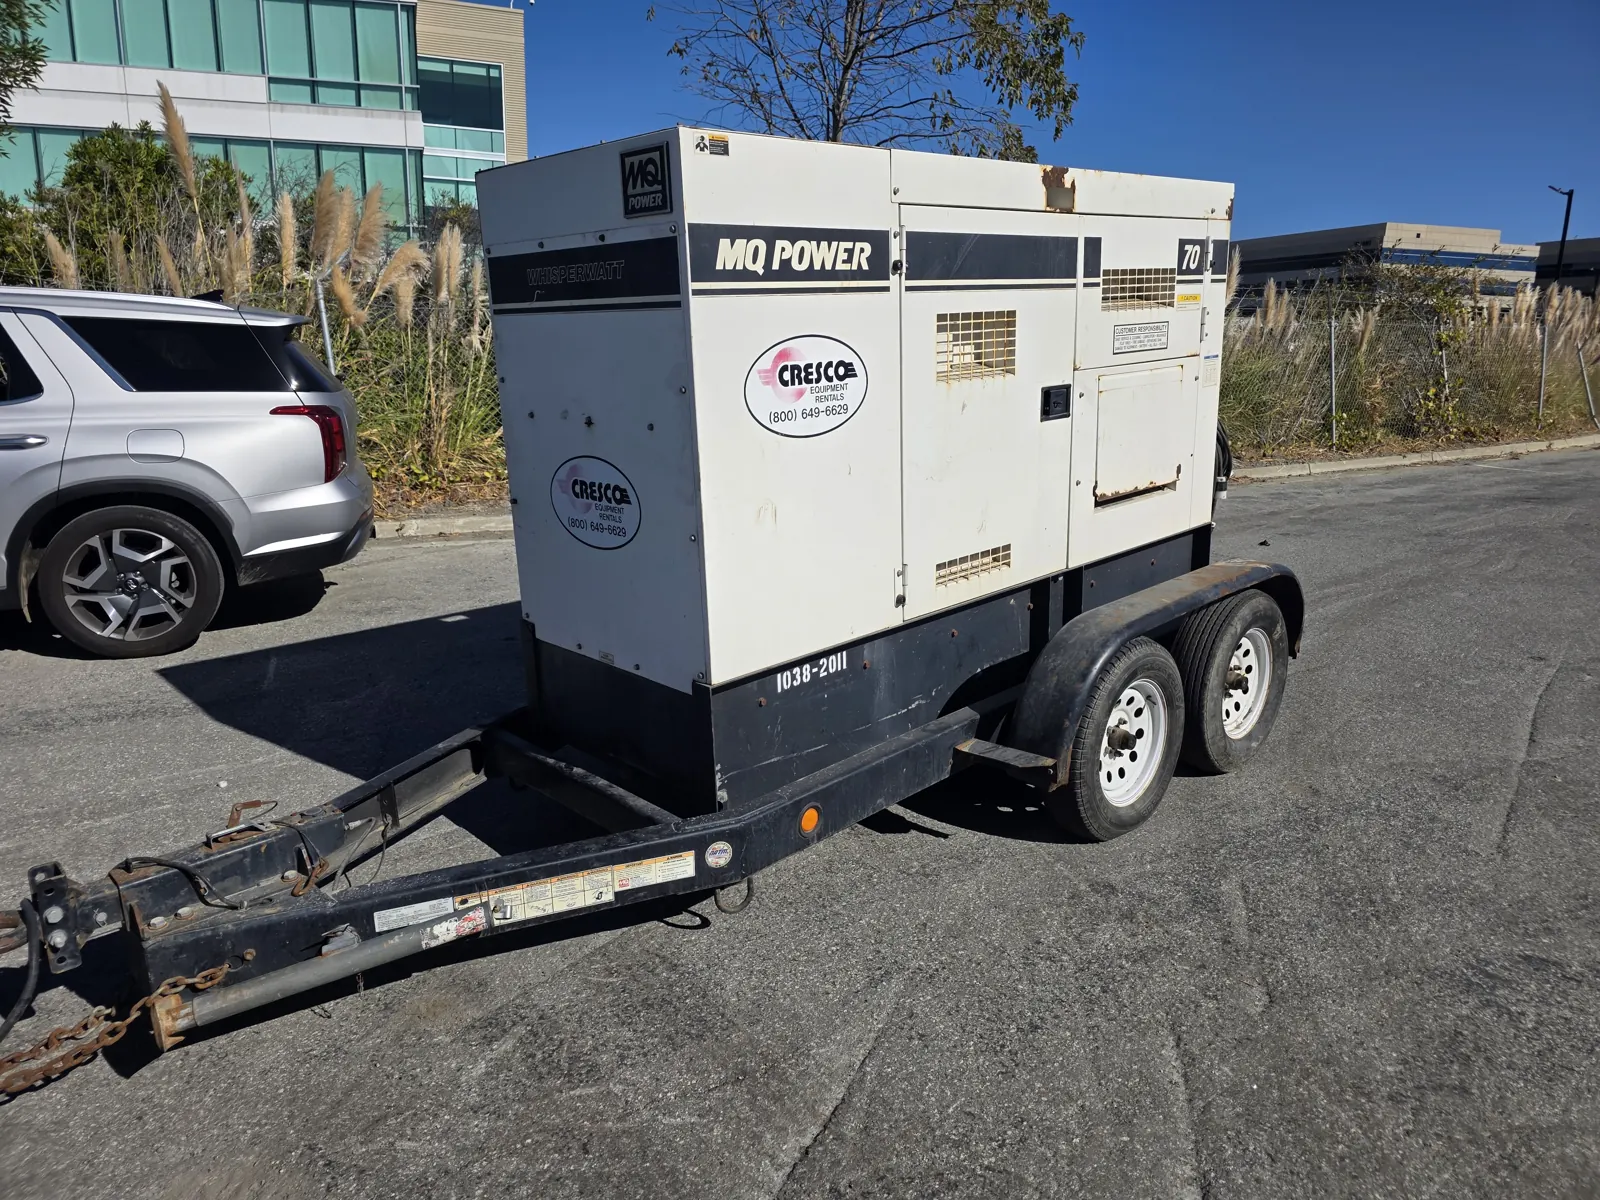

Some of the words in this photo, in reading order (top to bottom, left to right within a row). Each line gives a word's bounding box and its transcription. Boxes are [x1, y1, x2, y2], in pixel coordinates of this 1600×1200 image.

[625, 156, 661, 190] MQ
[628, 193, 662, 210] POWER
[716, 238, 767, 276] MQ
[772, 239, 872, 271] POWER
[1182, 244, 1200, 270] 70
[527, 260, 625, 286] WHISPERWATT
[778, 360, 858, 387] CRESCO
[810, 383, 848, 394] EQUIPMENT
[815, 393, 845, 404] RENTALS
[769, 408, 797, 425] (800)
[801, 403, 849, 420] 649-6629
[572, 479, 632, 505] CRESCO
[595, 503, 624, 514] EQUIPMENT
[599, 513, 622, 523] RENTALS
[567, 516, 588, 530] (800)
[590, 521, 626, 537] 649-6629
[777, 651, 847, 693] 1038-2011
